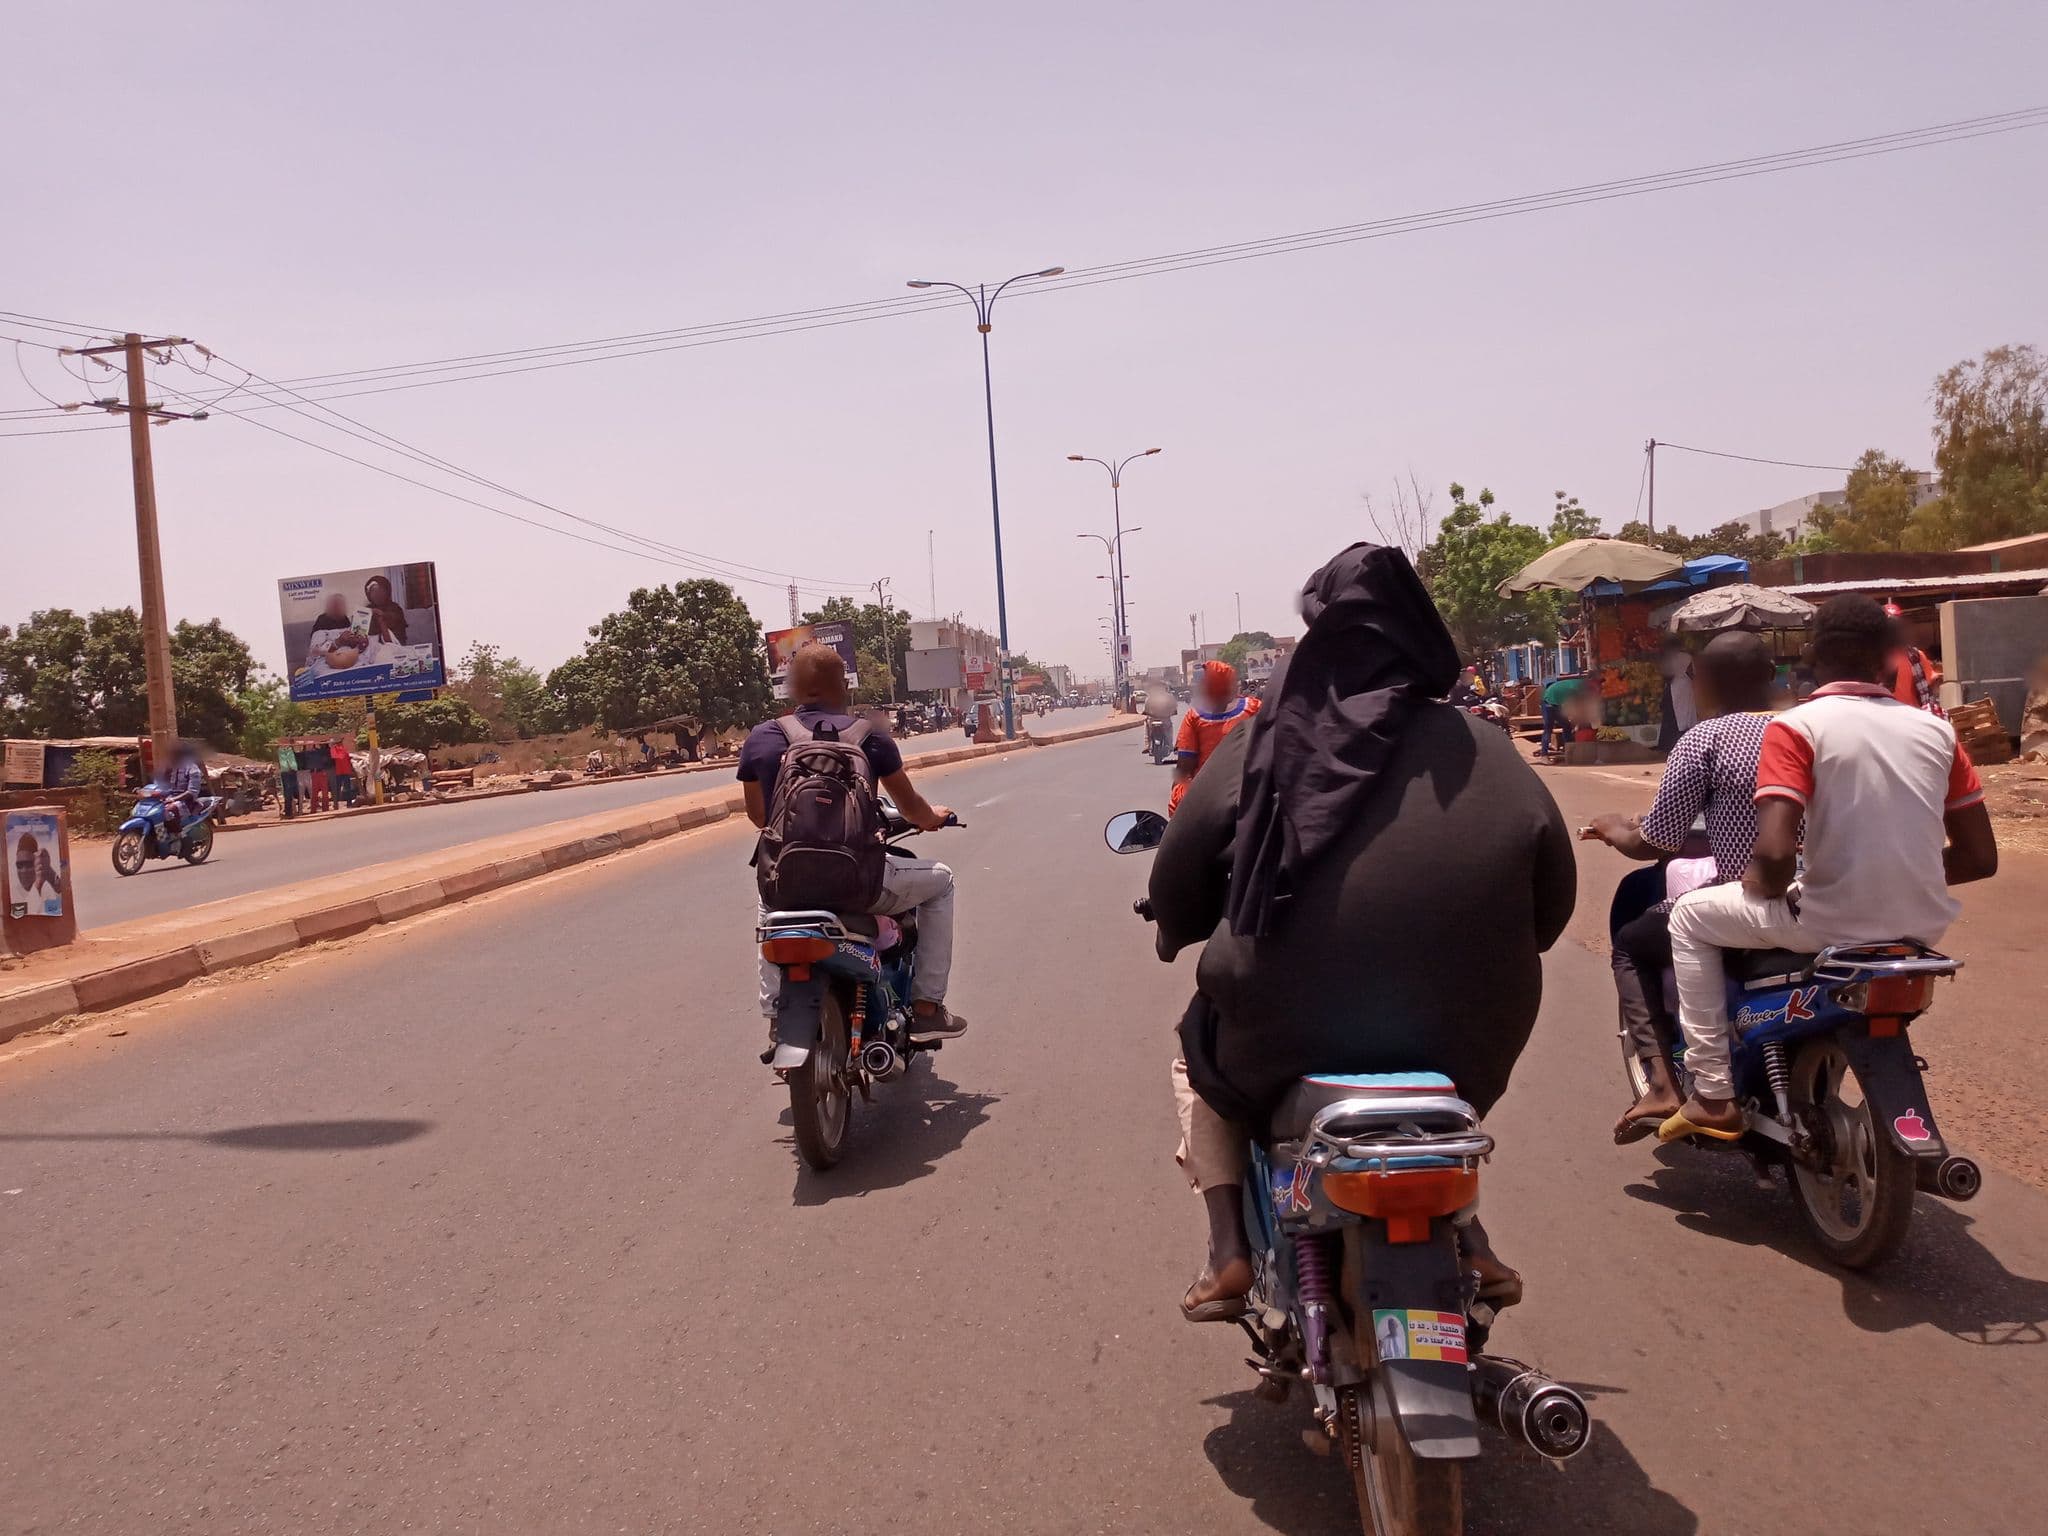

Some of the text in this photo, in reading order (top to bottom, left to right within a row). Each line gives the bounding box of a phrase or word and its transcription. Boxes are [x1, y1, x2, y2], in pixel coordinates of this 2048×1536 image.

[1736, 985, 1819, 1027] Power K
[1291, 1161, 1313, 1212] K
